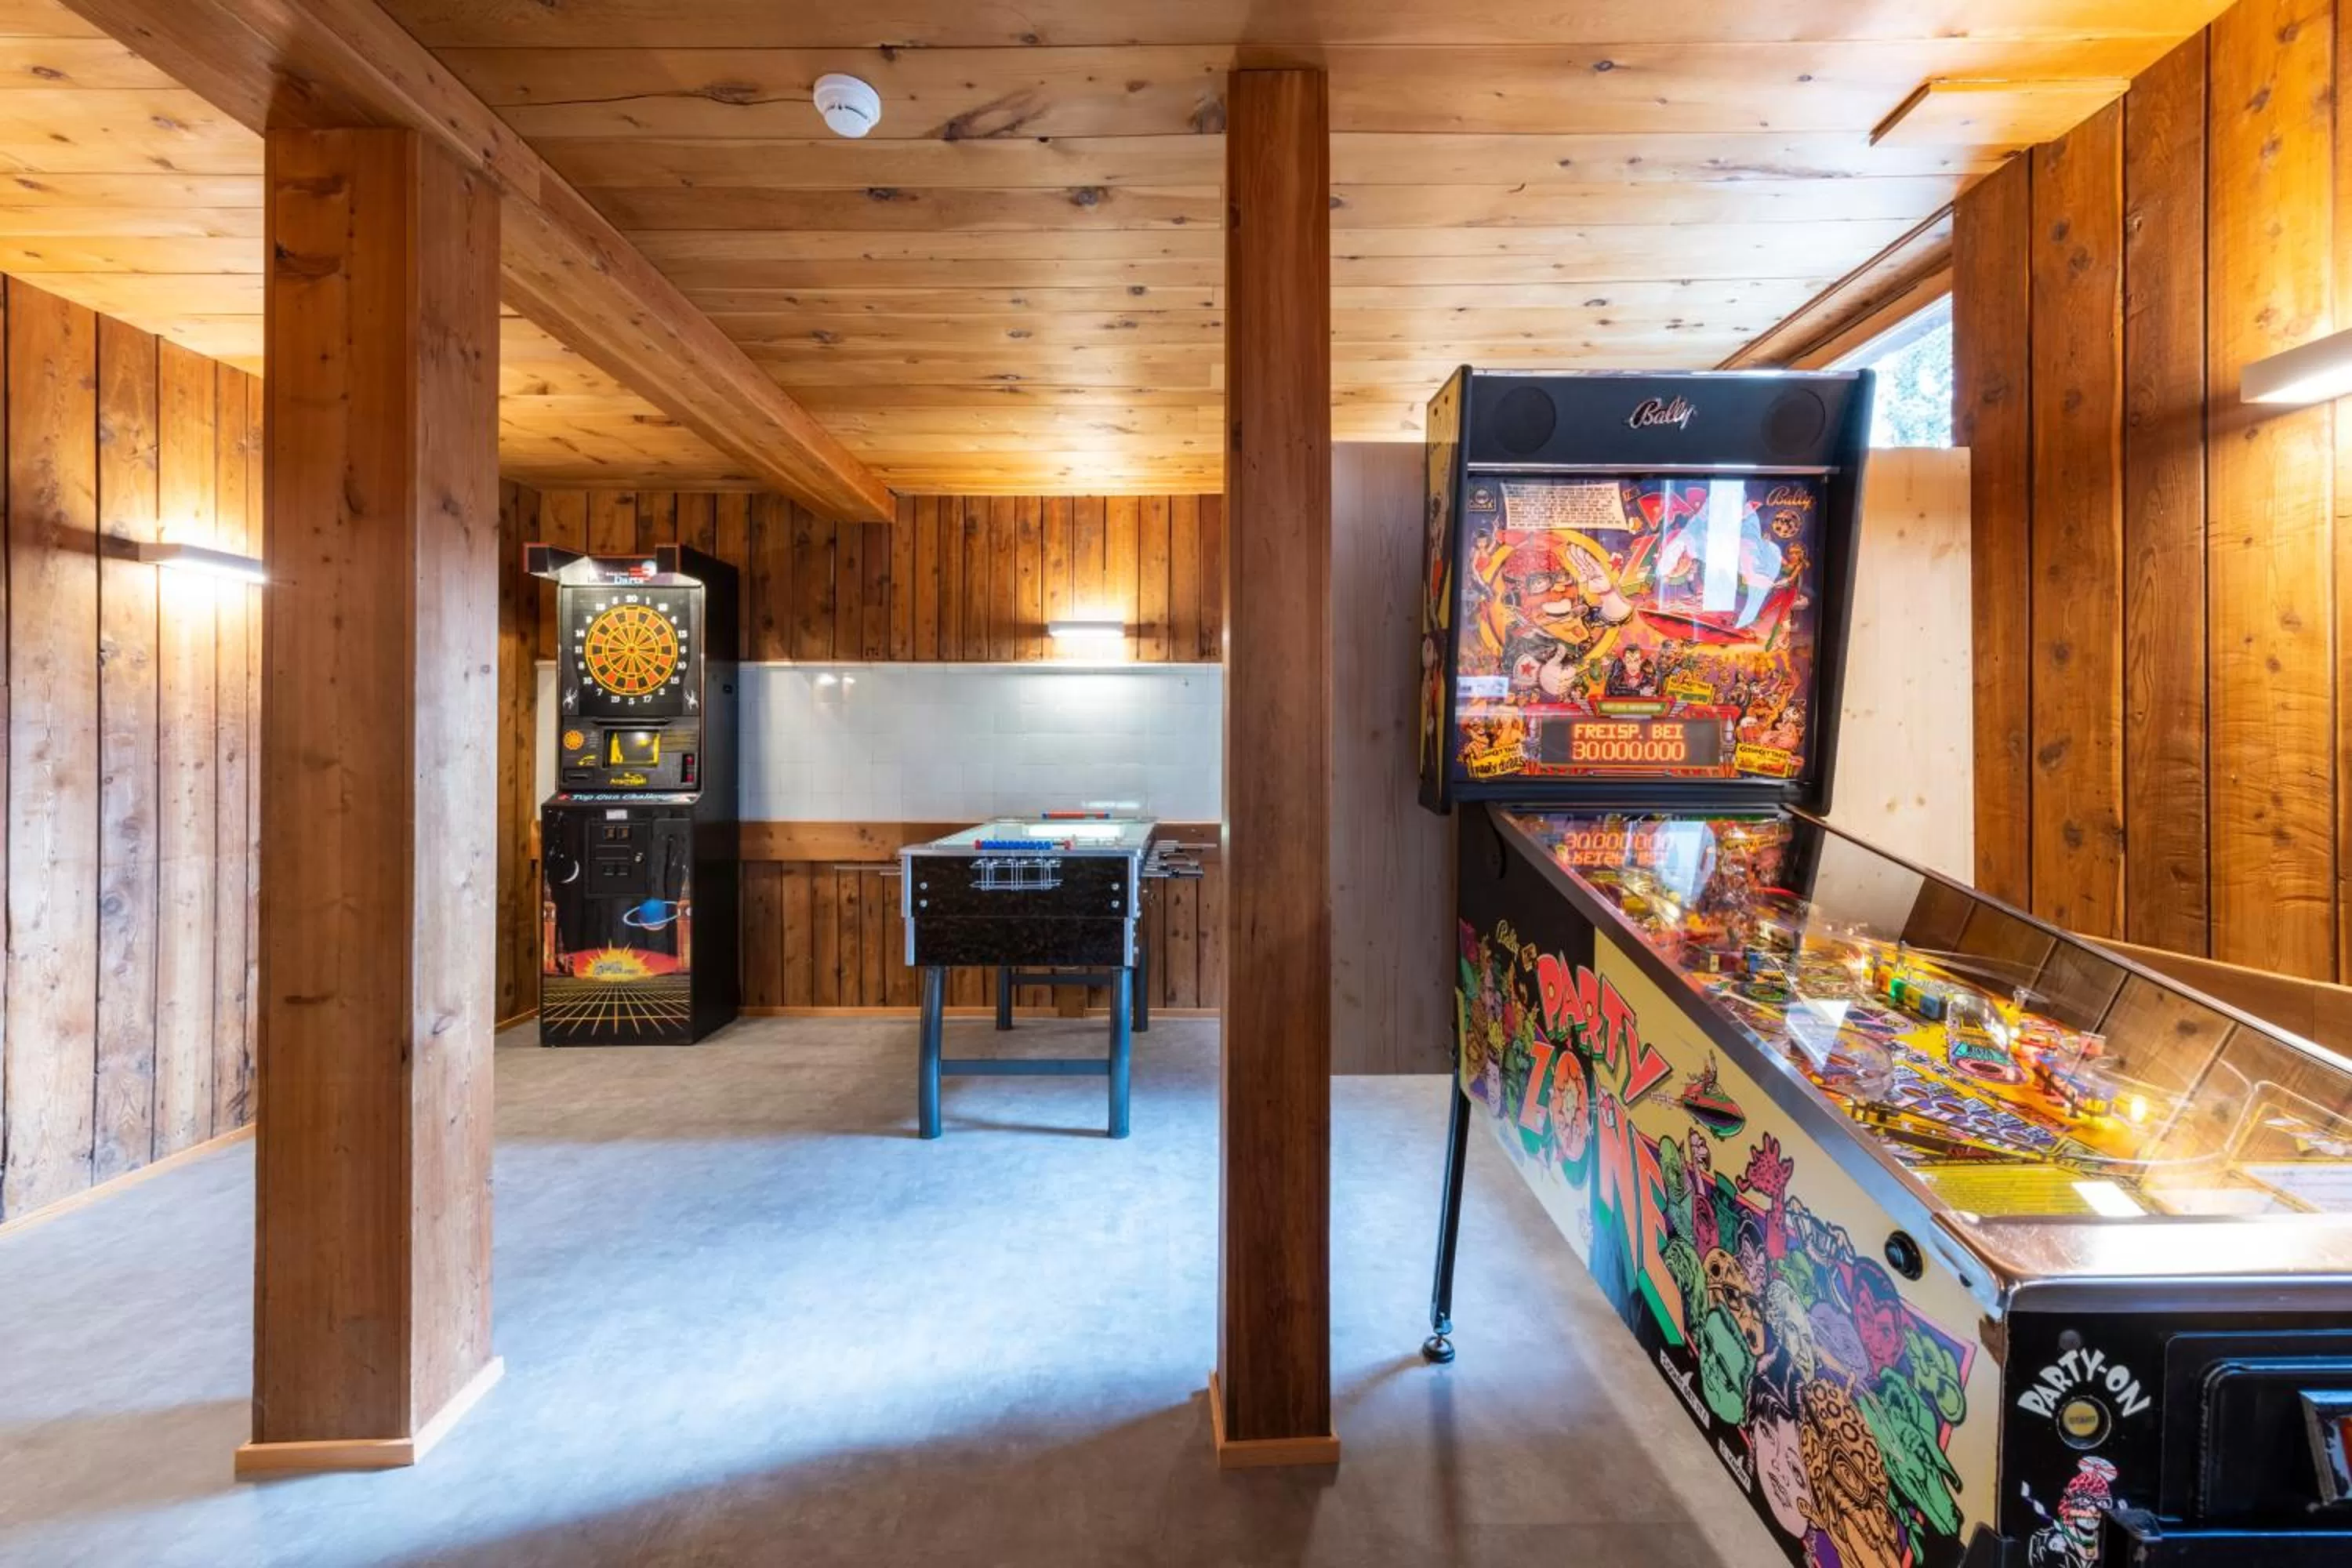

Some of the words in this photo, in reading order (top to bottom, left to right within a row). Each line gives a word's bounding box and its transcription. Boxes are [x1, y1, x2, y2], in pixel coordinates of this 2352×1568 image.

[1629, 395, 1697, 430] Bally
[1766, 485, 1817, 510] Bally
[1574, 724, 1643, 739] FREISP.
[1652, 724, 1683, 739] BEI
[1537, 953, 1672, 1105] PARTY
[1519, 1041, 1685, 1345] ZONE
[2017, 1348, 2151, 1418] PARTY-ON
